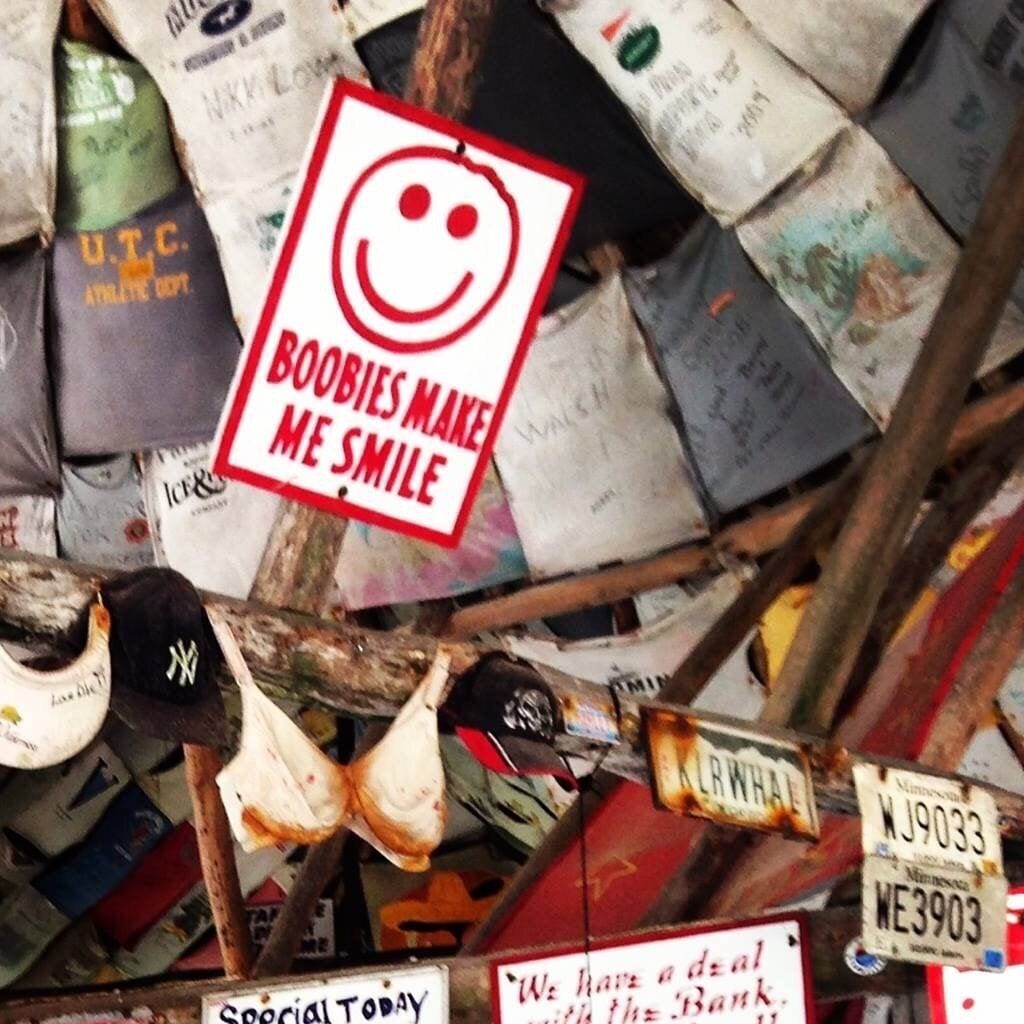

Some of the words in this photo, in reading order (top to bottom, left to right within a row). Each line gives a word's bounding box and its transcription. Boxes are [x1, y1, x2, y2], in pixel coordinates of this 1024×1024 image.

[266, 328, 407, 420] BOOBIES
[400, 378, 494, 452] MAKE
[268, 404, 333, 467] ME
[330, 428, 448, 506] SMILE
[878, 793, 986, 856] WJ9033
[875, 879, 983, 946] WE3903
[517, 972, 561, 1005] We
[576, 967, 644, 997] have
[656, 964, 676, 986] a
[687, 940, 766, 980] deal
